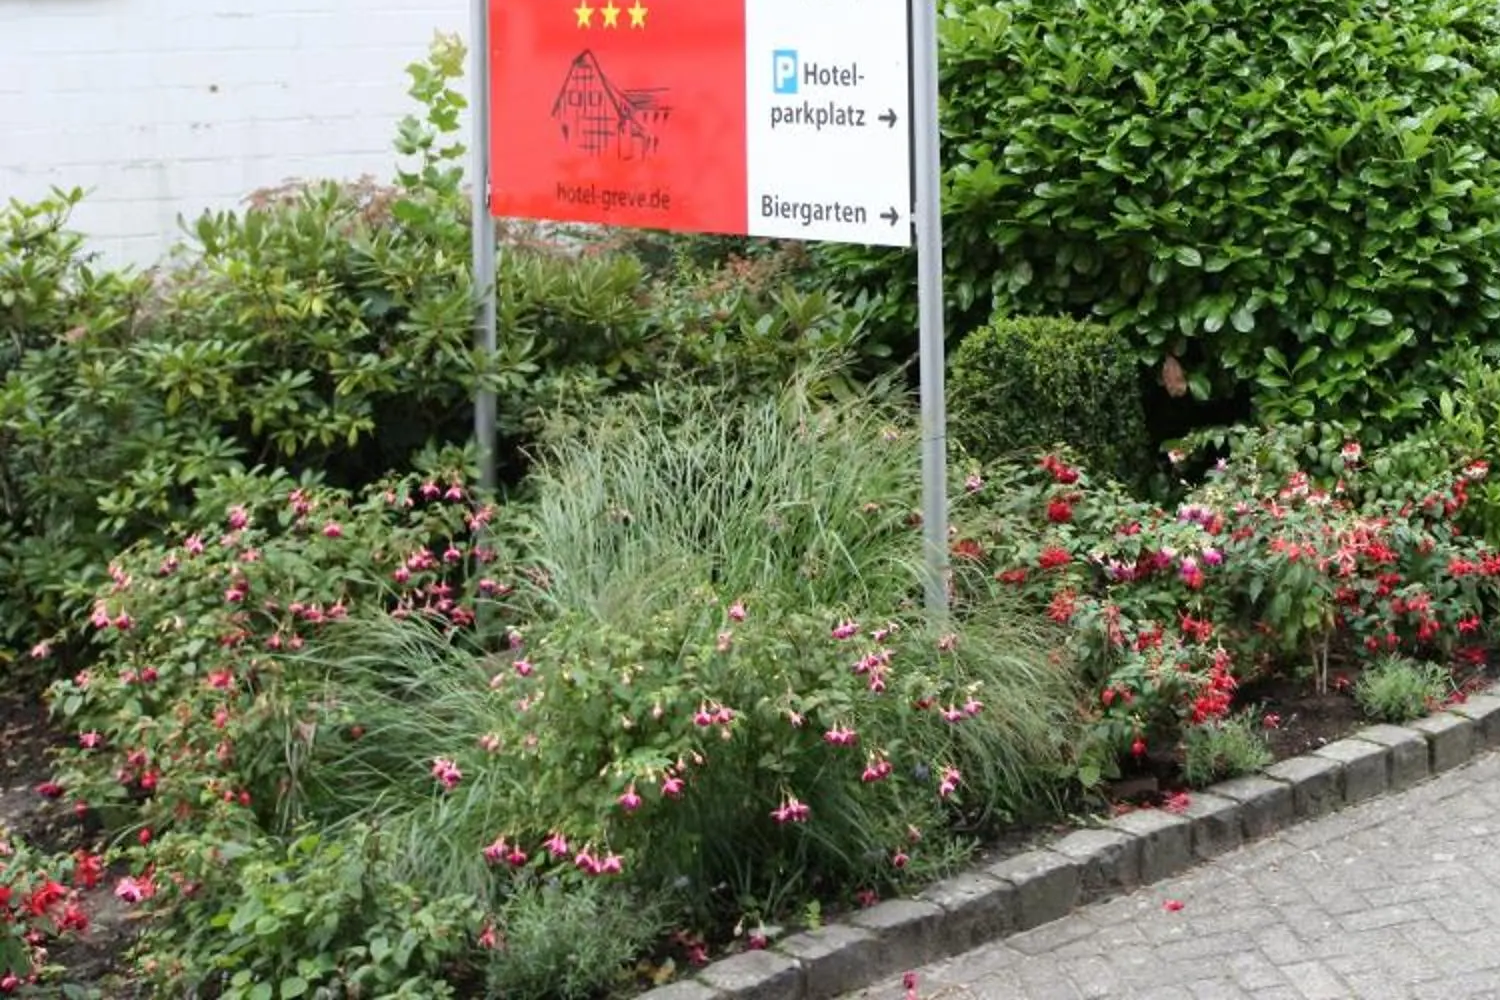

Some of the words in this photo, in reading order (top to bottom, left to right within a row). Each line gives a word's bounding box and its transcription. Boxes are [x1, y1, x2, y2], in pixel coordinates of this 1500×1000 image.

[803, 62, 865, 87] Hotel-
[771, 101, 866, 131] parkplatz
[556, 182, 671, 210] hotel-greve.de
[761, 195, 867, 225] Biergarten
